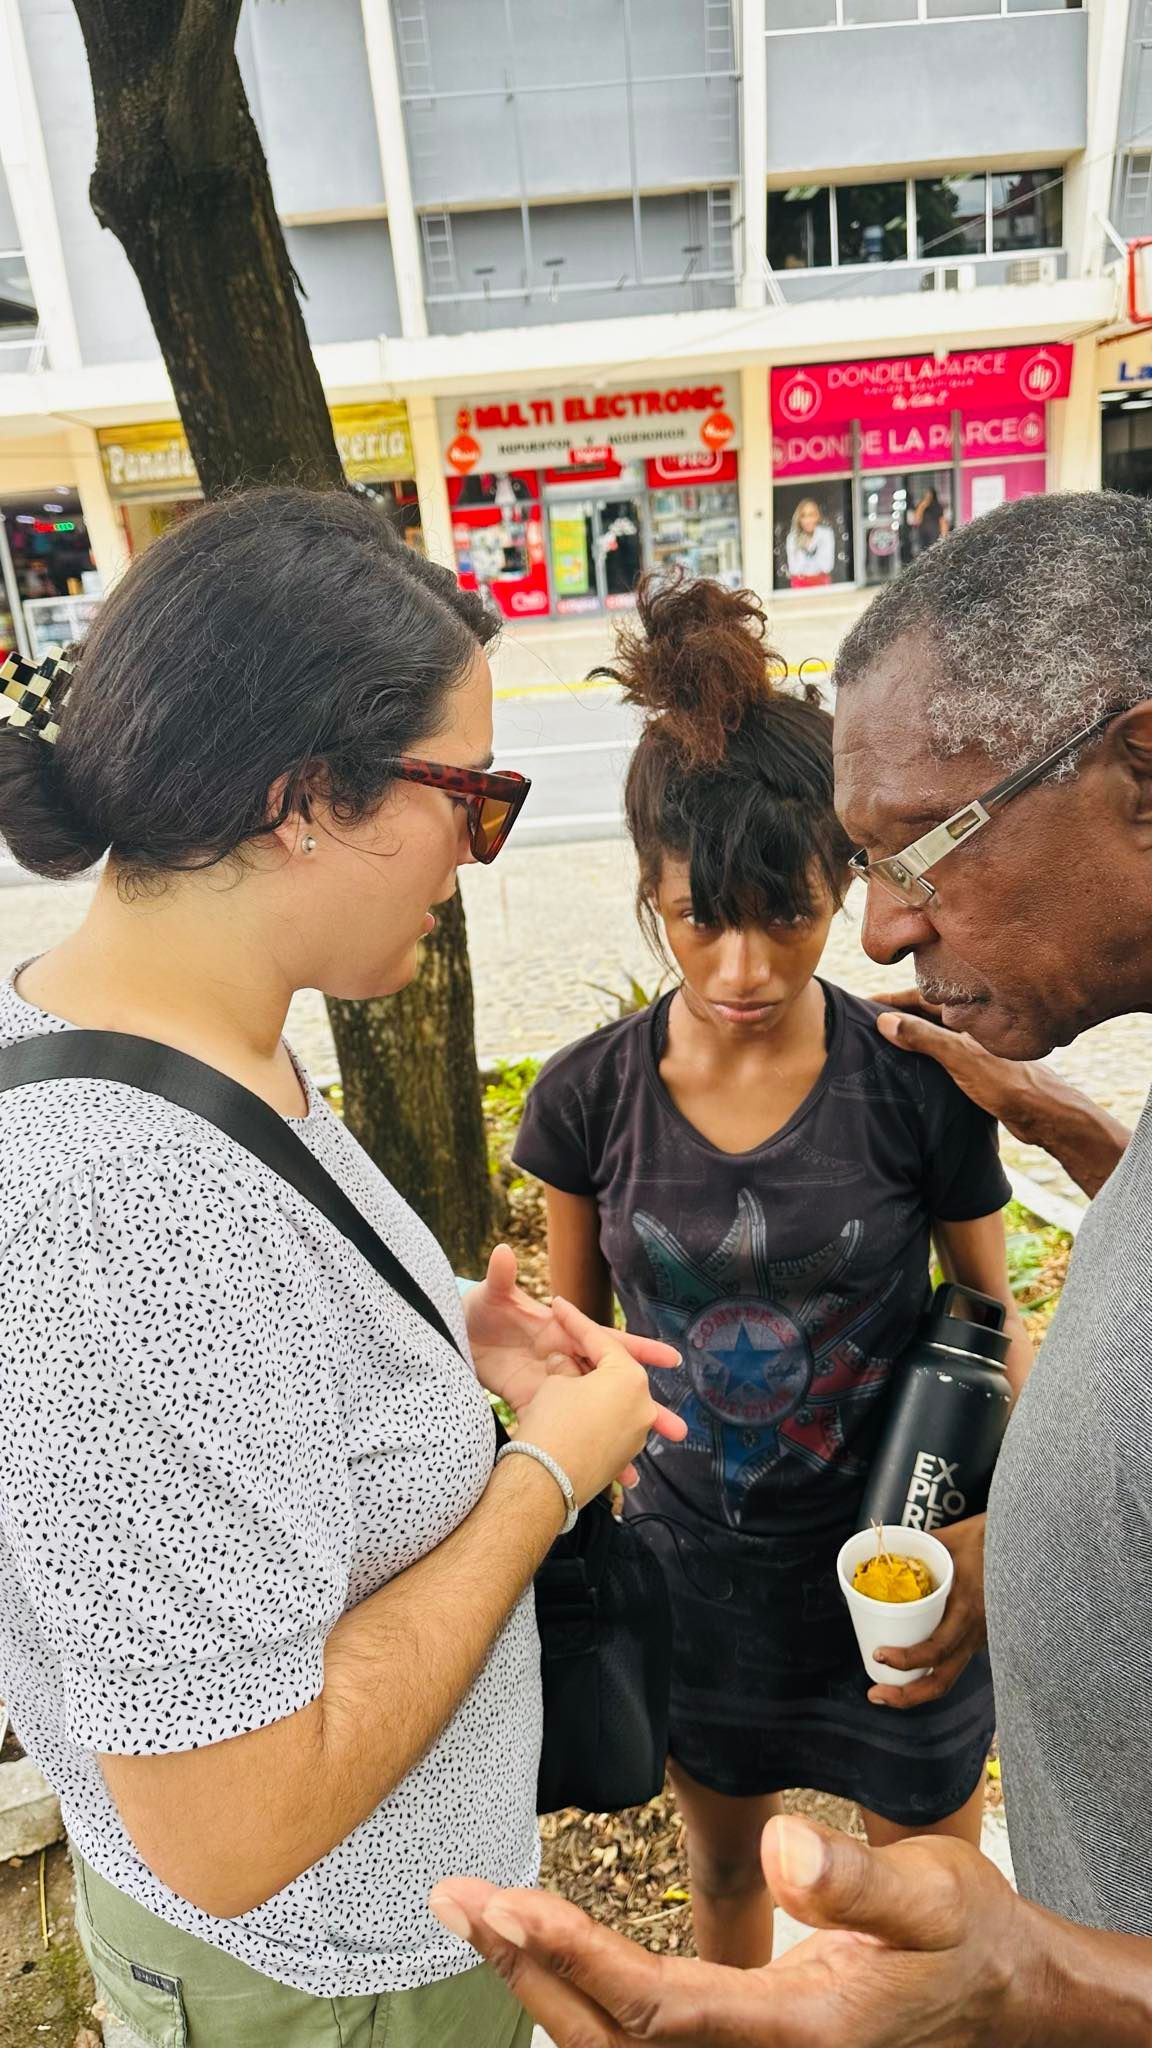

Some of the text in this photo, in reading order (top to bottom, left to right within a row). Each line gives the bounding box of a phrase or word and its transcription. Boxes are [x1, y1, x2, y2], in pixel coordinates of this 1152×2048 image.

[827, 352, 1007, 389] DONDELAPARCE
[474, 385, 724, 430] MULTI ELECTRONIC
[888, 426, 925, 454] LA
[929, 412, 1020, 449] PARCE
[913, 1450, 959, 1488] EX
[907, 1475, 966, 1516] PLO
